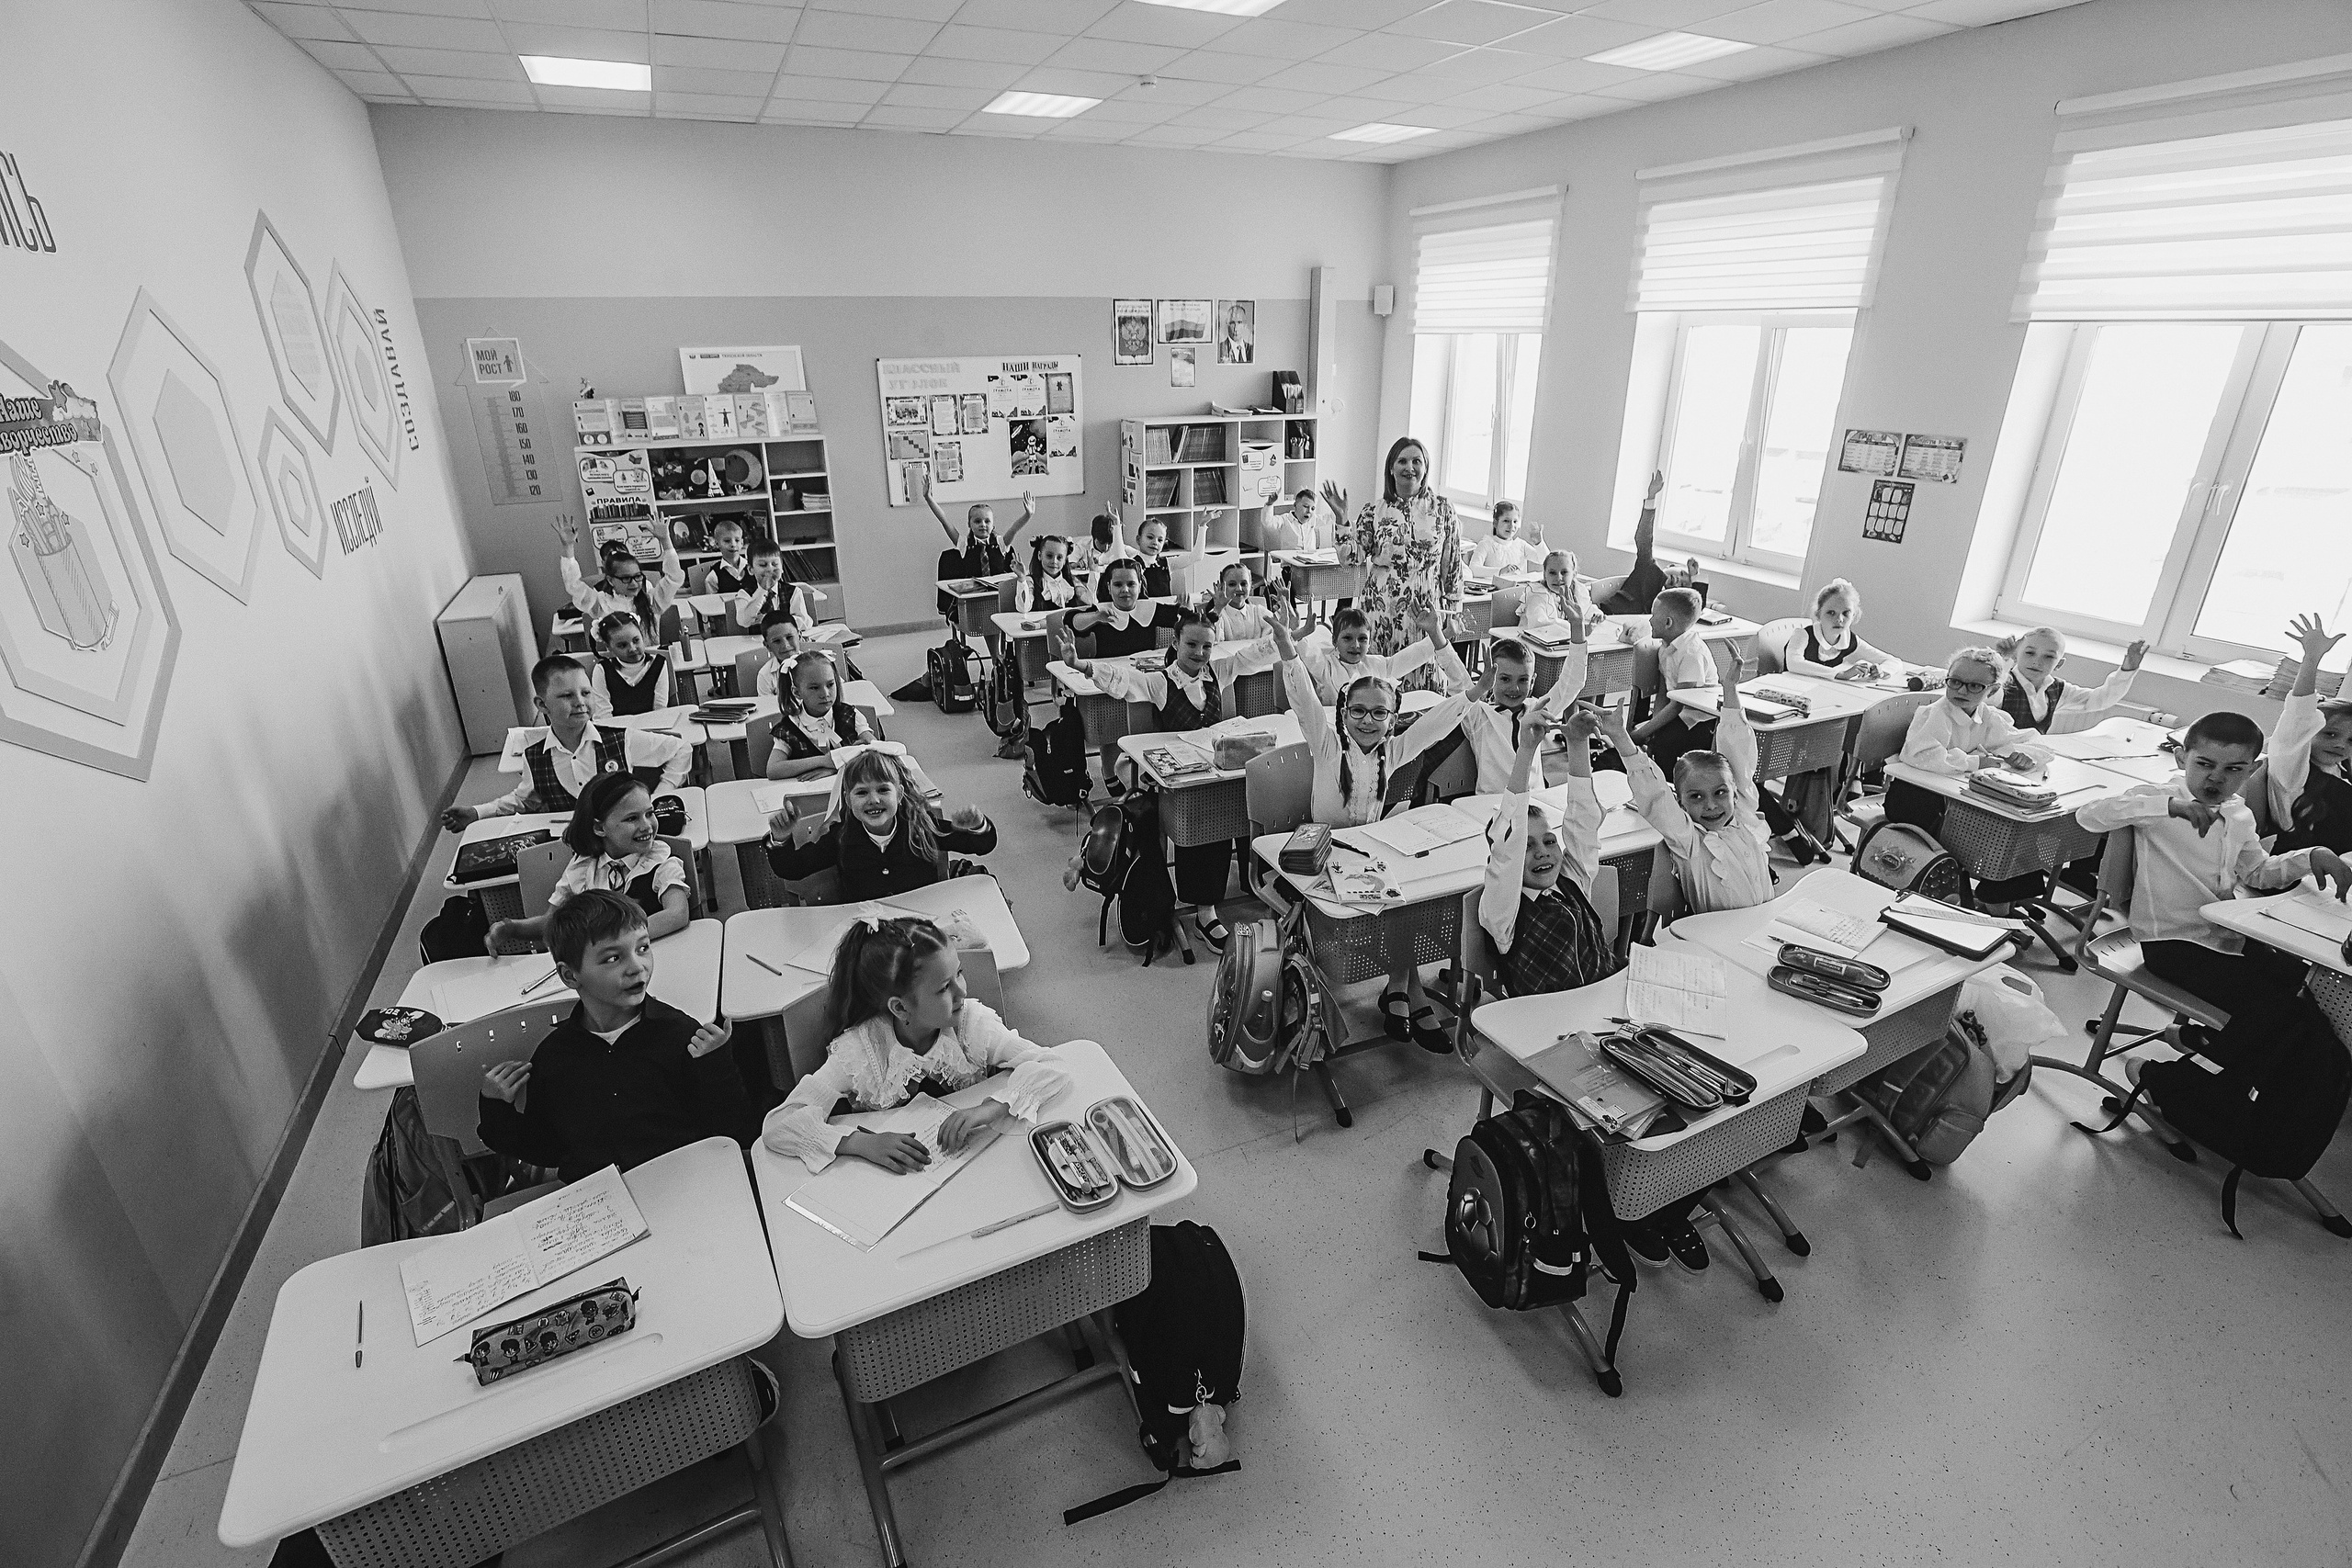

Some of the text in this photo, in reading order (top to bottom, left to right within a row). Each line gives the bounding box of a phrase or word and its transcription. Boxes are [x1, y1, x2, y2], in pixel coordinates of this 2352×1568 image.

[475, 349, 498, 361] МОЙ
[479, 363, 503, 375] РОСТ
[1002, 361, 1058, 372] НАШИ НАГРАДЫ
[508, 390, 521, 402] 180
[512, 406, 525, 418] 170
[515, 423, 528, 434] 160
[0, 423, 79, 457] ворчество
[519, 438, 531, 449] 150
[522, 454, 535, 465] 140
[526, 469, 538, 480] 130
[528, 485, 541, 496] 120
[596, 496, 641, 505] ПРАВИЛА
[330, 476, 384, 556] ИССЛЕДУЙ
